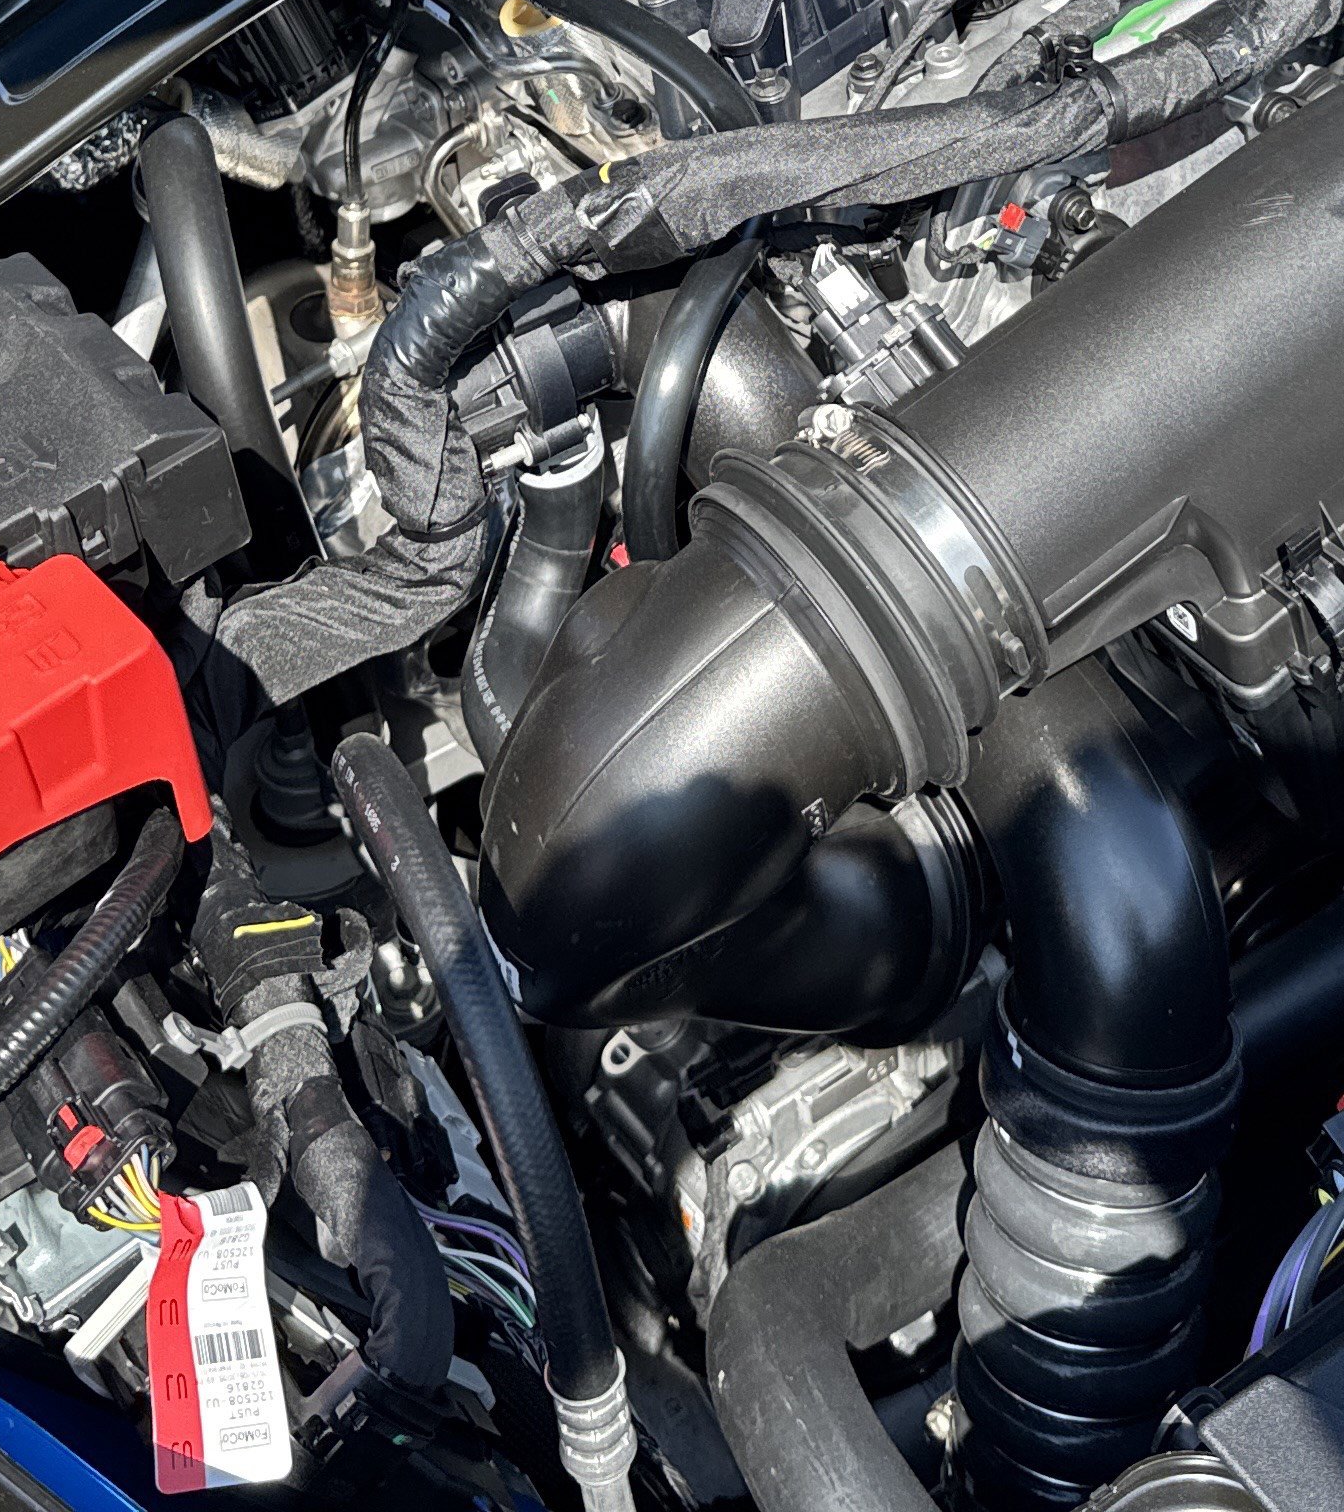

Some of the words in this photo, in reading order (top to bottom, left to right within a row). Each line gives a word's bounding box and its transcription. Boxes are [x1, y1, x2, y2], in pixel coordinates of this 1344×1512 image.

[168, 1238, 192, 1262] UJ
[203, 1283, 246, 1296] FoMoCo
[159, 1298, 180, 1326] UJ
[165, 1373, 188, 1401] UJ
[222, 1428, 268, 1445] FoMoCo
[171, 1440, 194, 1470] UJ
